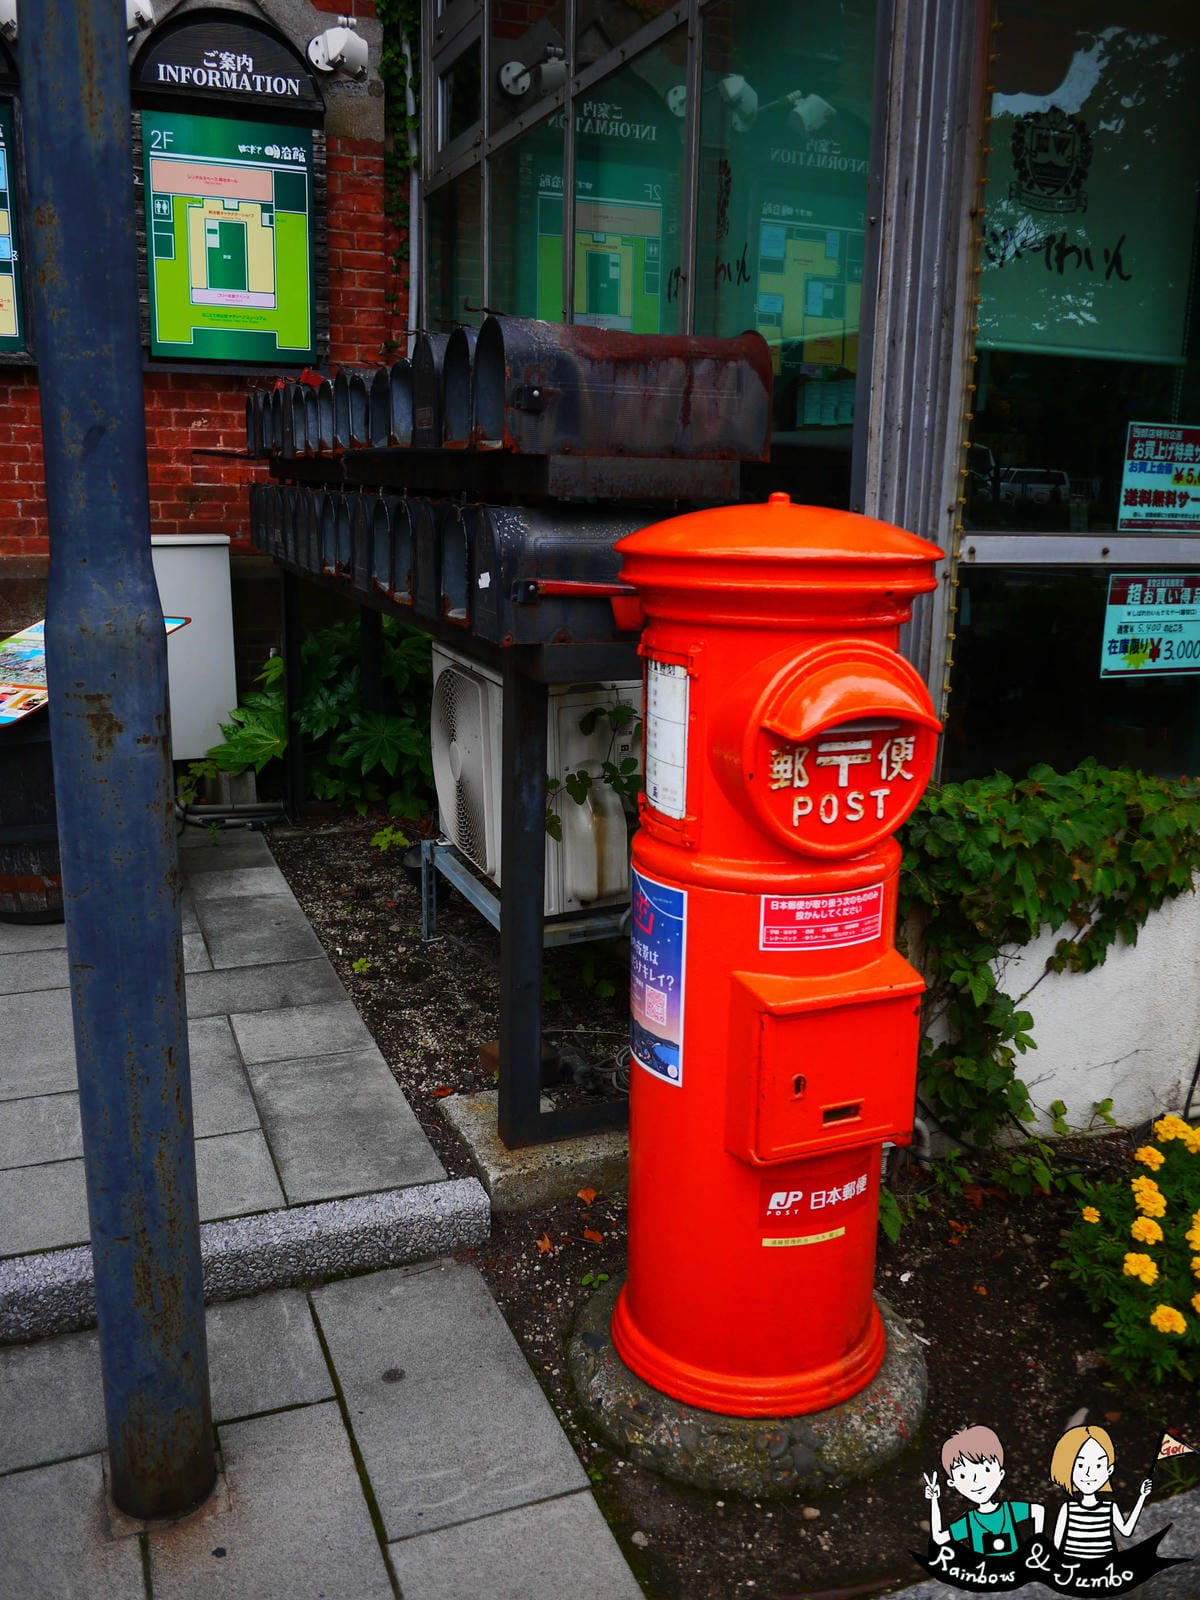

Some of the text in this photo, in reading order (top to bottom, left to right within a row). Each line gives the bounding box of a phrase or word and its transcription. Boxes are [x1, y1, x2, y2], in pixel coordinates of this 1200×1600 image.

[203, 50, 254, 73] ご案内
[157, 63, 301, 96] INFORMATION
[150, 130, 174, 149] 2F
[1107, 638, 1149, 656] 在庫限り
[792, 788, 891, 827] POST
[795, 905, 863, 921] 投かんしてください
[810, 1173, 868, 1211] 日本郵便
[766, 1208, 799, 1217] POST
